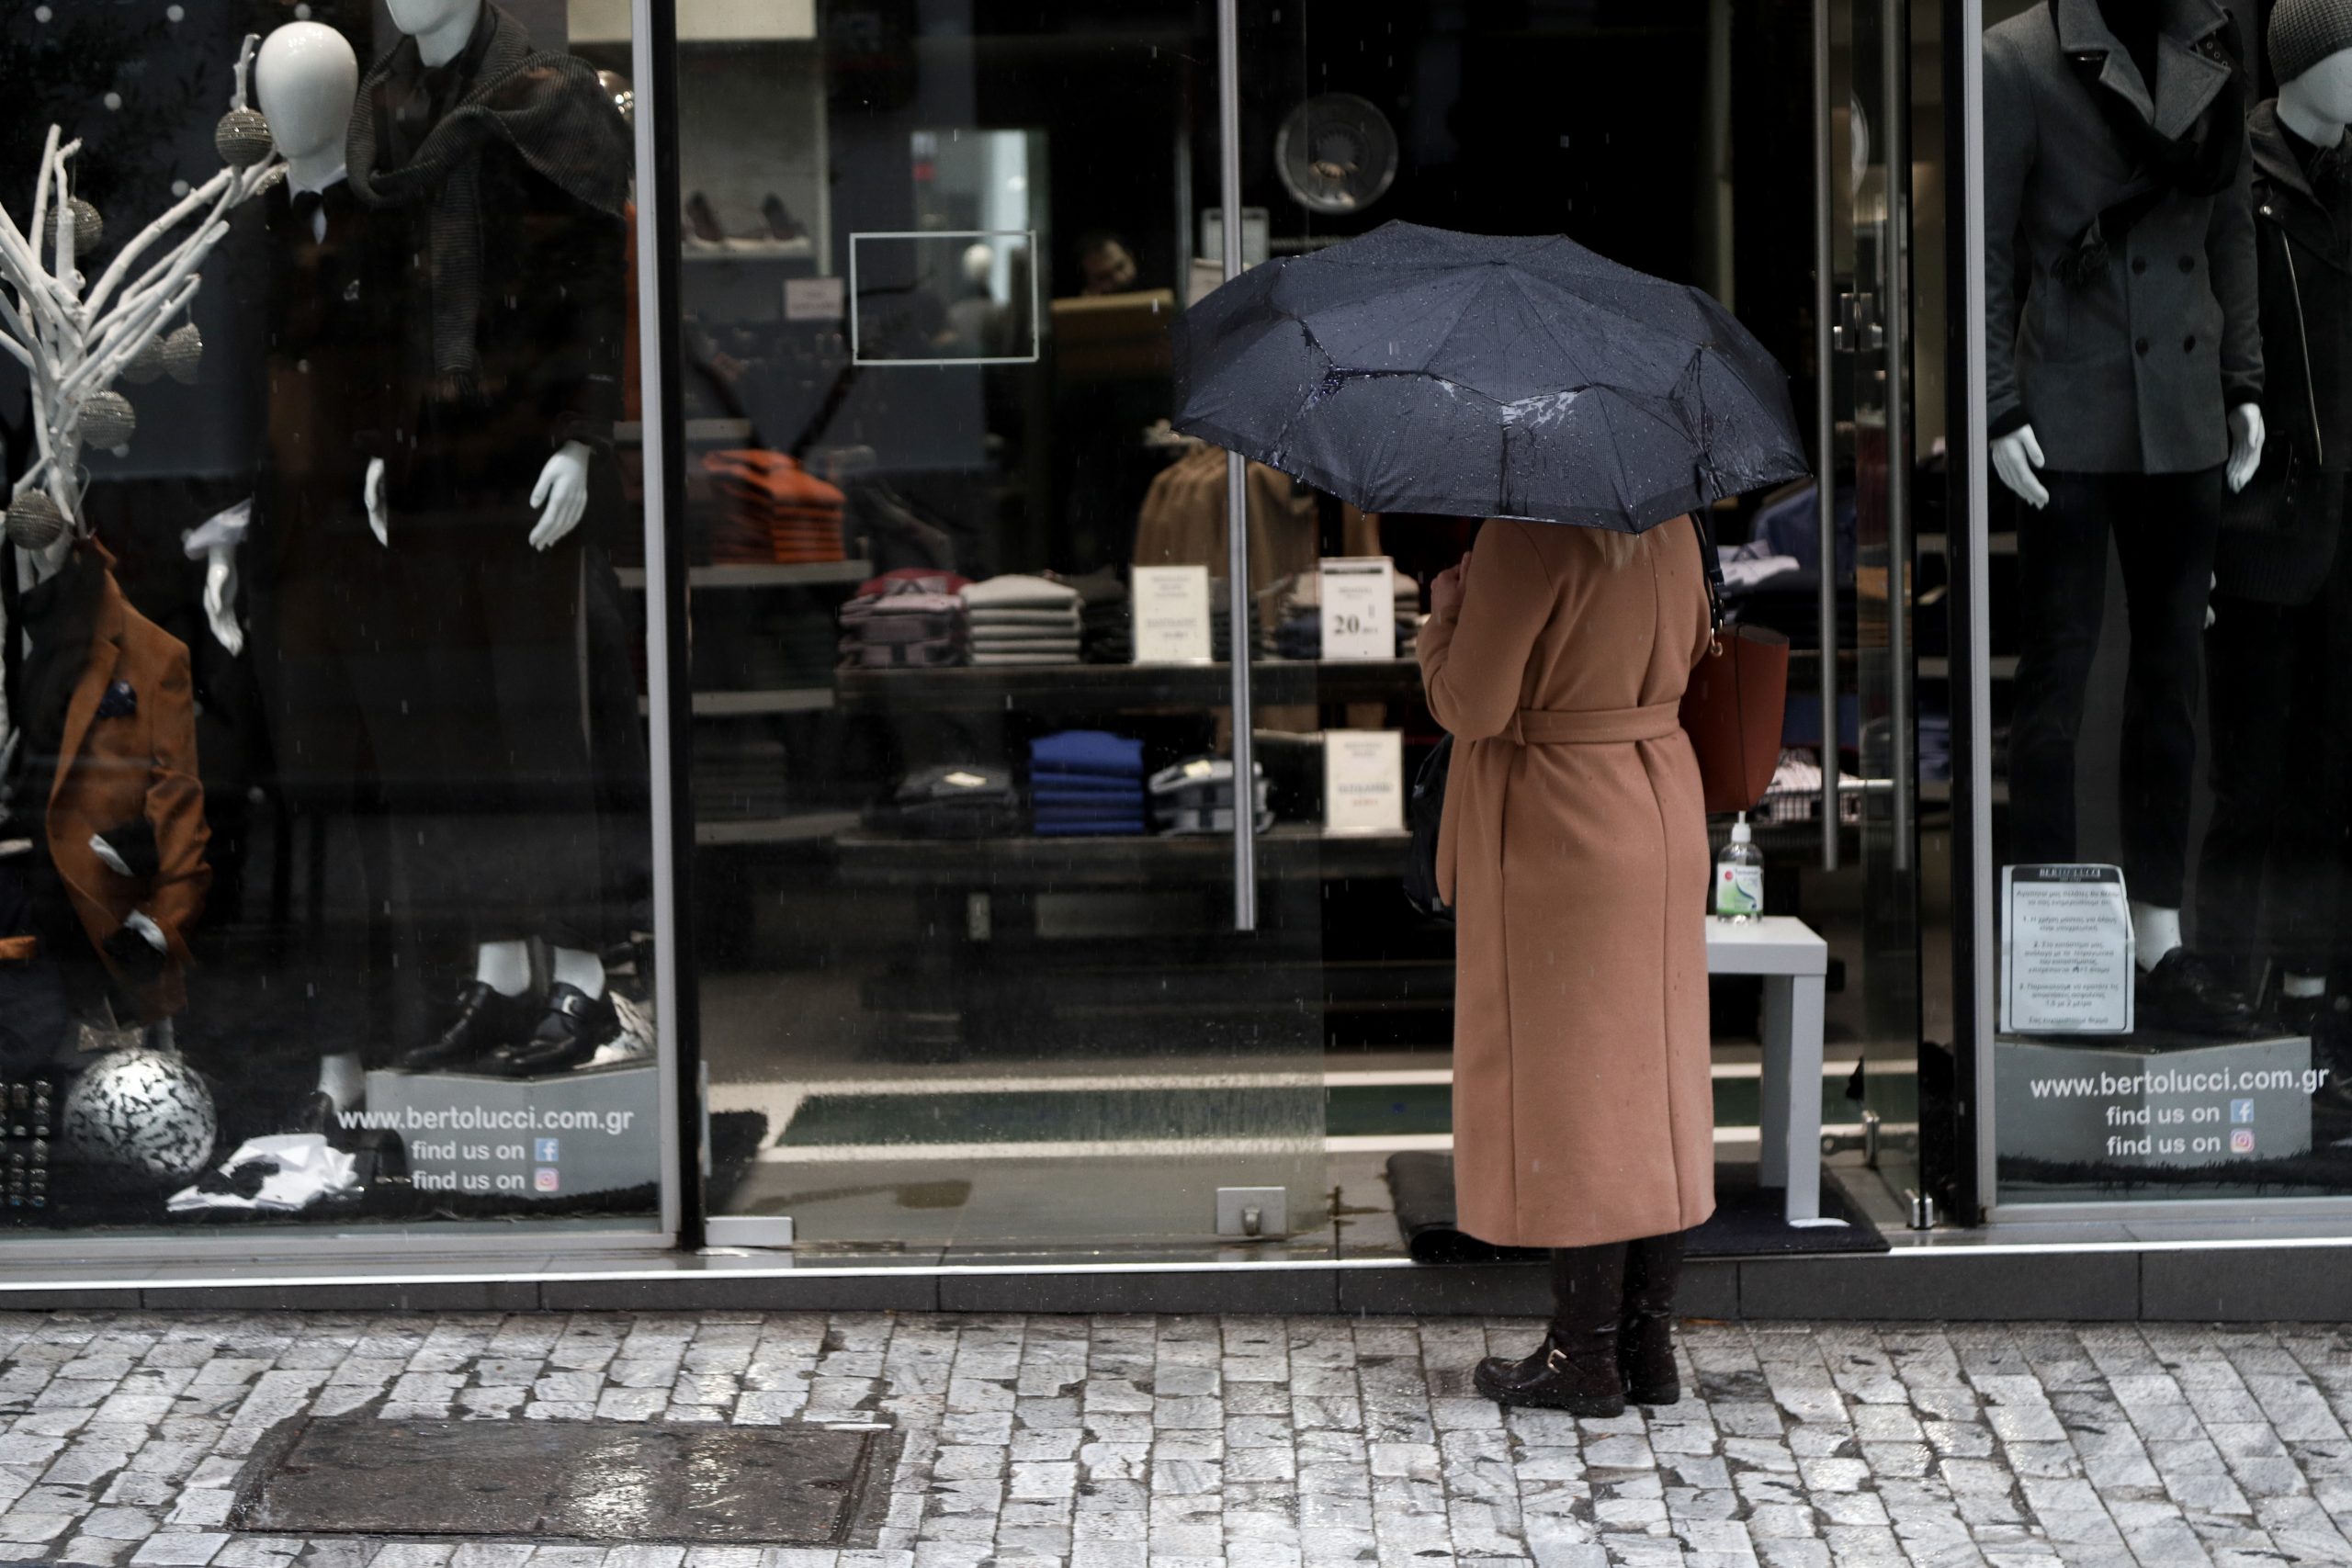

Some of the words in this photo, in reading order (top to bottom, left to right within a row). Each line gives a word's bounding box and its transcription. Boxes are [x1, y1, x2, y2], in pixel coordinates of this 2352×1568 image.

[2030, 1066, 2330, 1098] www.bertolucci.com.gr
[337, 1106, 634, 1134] www.bertolucci.com.gr
[2106, 1105, 2151, 1125] find
[2158, 1108, 2185, 1123] us
[2191, 1108, 2221, 1122] on
[412, 1139, 457, 1160] find
[462, 1144, 490, 1160] us
[495, 1144, 526, 1160] on
[2106, 1135, 2152, 1156] find
[2159, 1139, 2186, 1154] us
[2192, 1138, 2222, 1153] on
[413, 1170, 457, 1190] find
[462, 1174, 490, 1190] us
[495, 1174, 526, 1190] on
